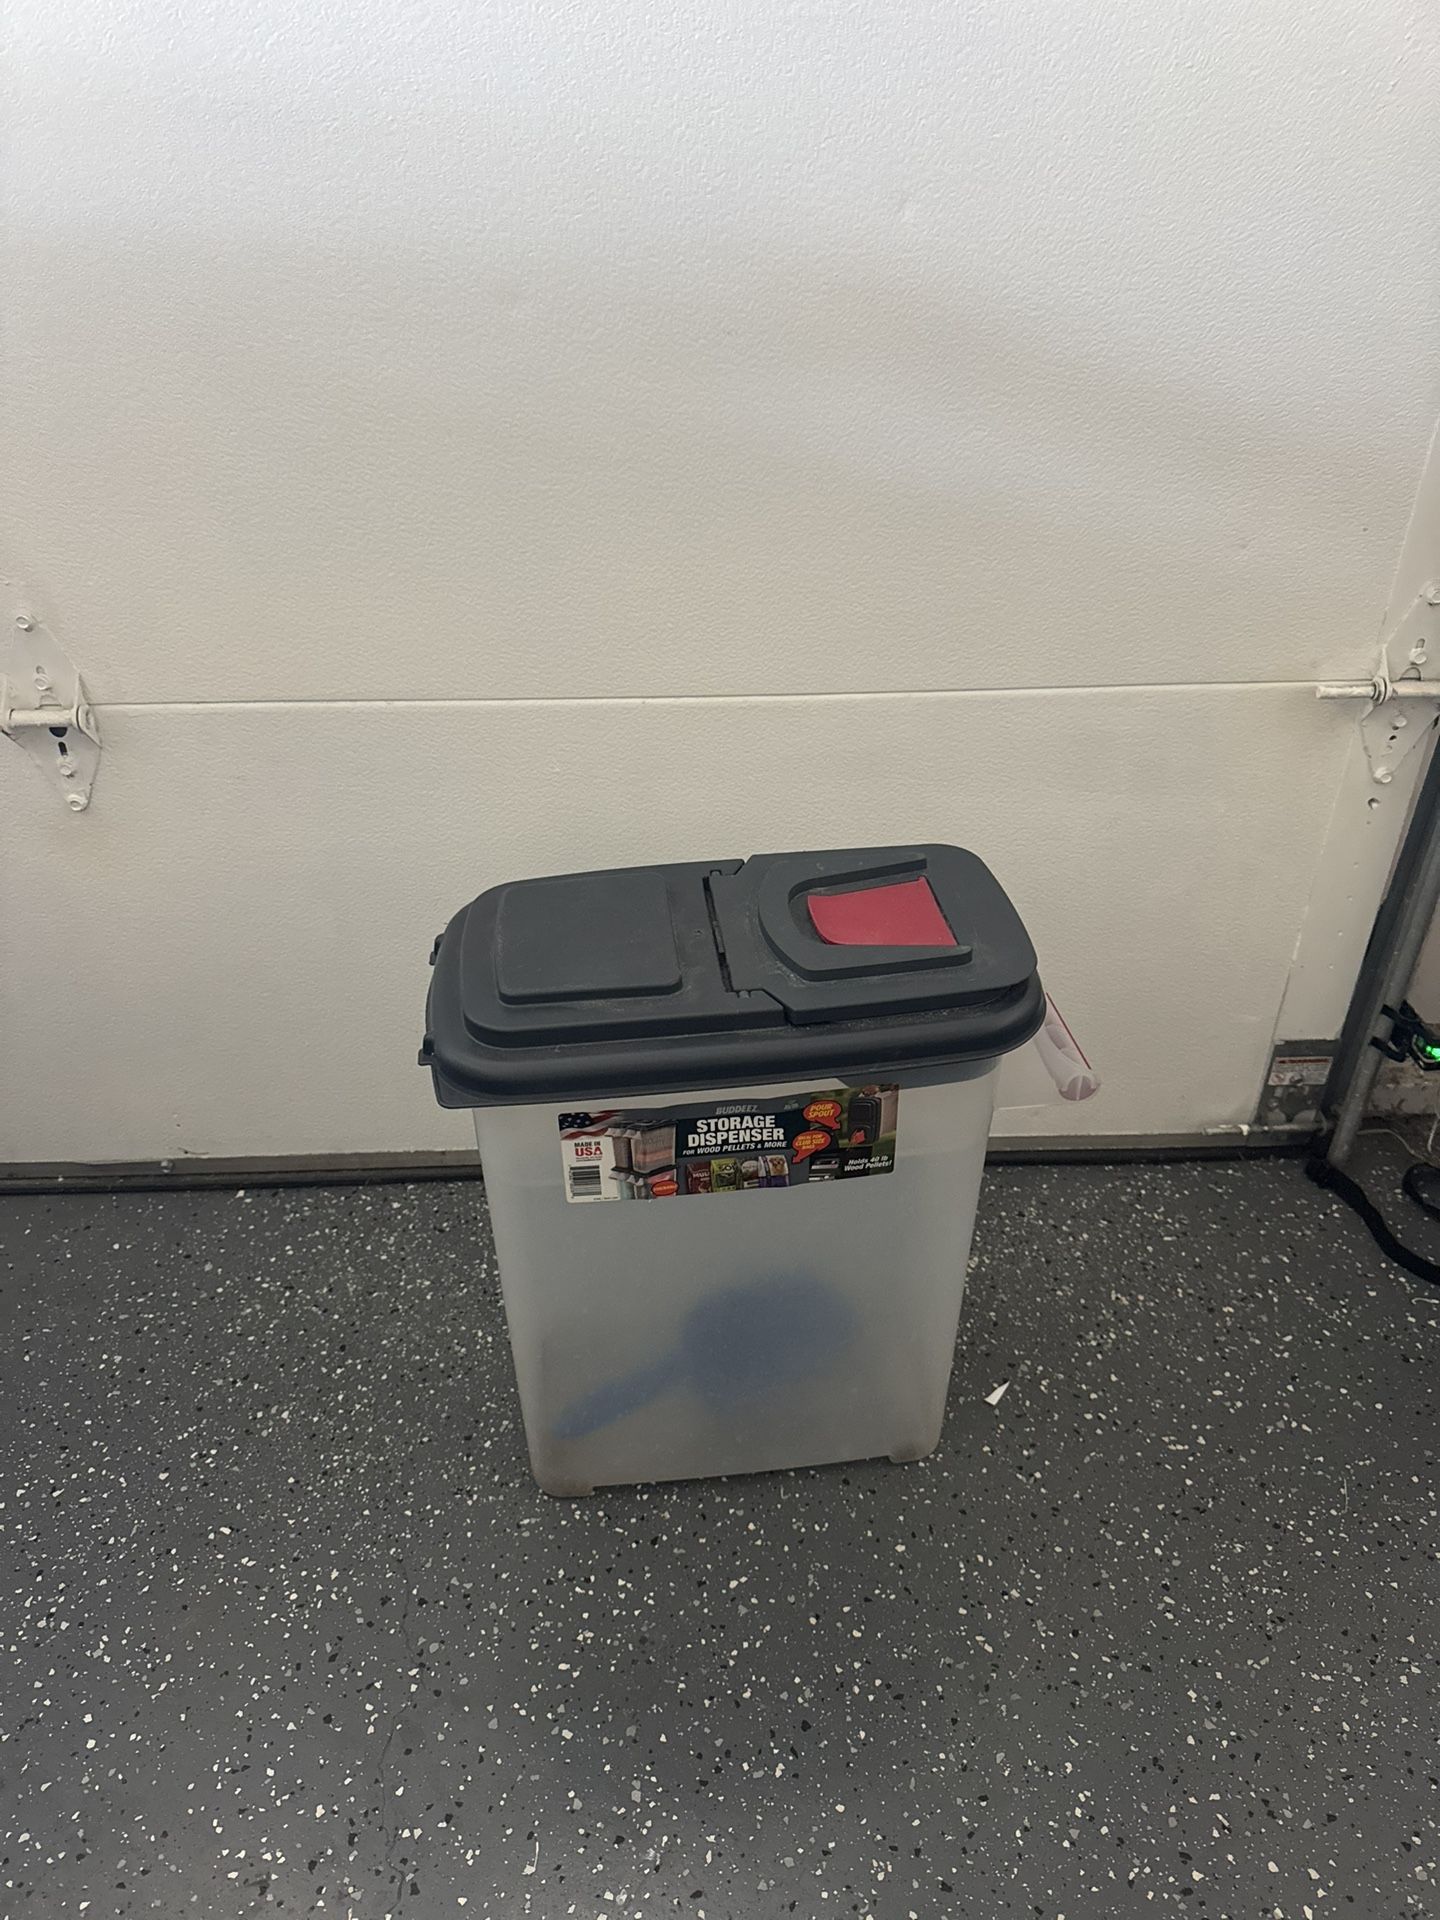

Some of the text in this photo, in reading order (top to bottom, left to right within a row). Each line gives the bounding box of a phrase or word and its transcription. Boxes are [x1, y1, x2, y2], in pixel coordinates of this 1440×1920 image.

[715, 1104, 758, 1115] BUDDEEZ
[808, 1109, 835, 1118] SPOUT
[810, 1104, 833, 1112] POUR
[696, 1115, 775, 1133] STORAGE
[688, 1127, 785, 1147] DISPENSER
[575, 1146, 603, 1156] USA
[696, 1146, 721, 1155] WOOD
[722, 1142, 755, 1152] PELLETS
[763, 1141, 788, 1149] MORE
[844, 1160, 893, 1172] Wood Pellets!
[848, 1158, 868, 1166] Holds
